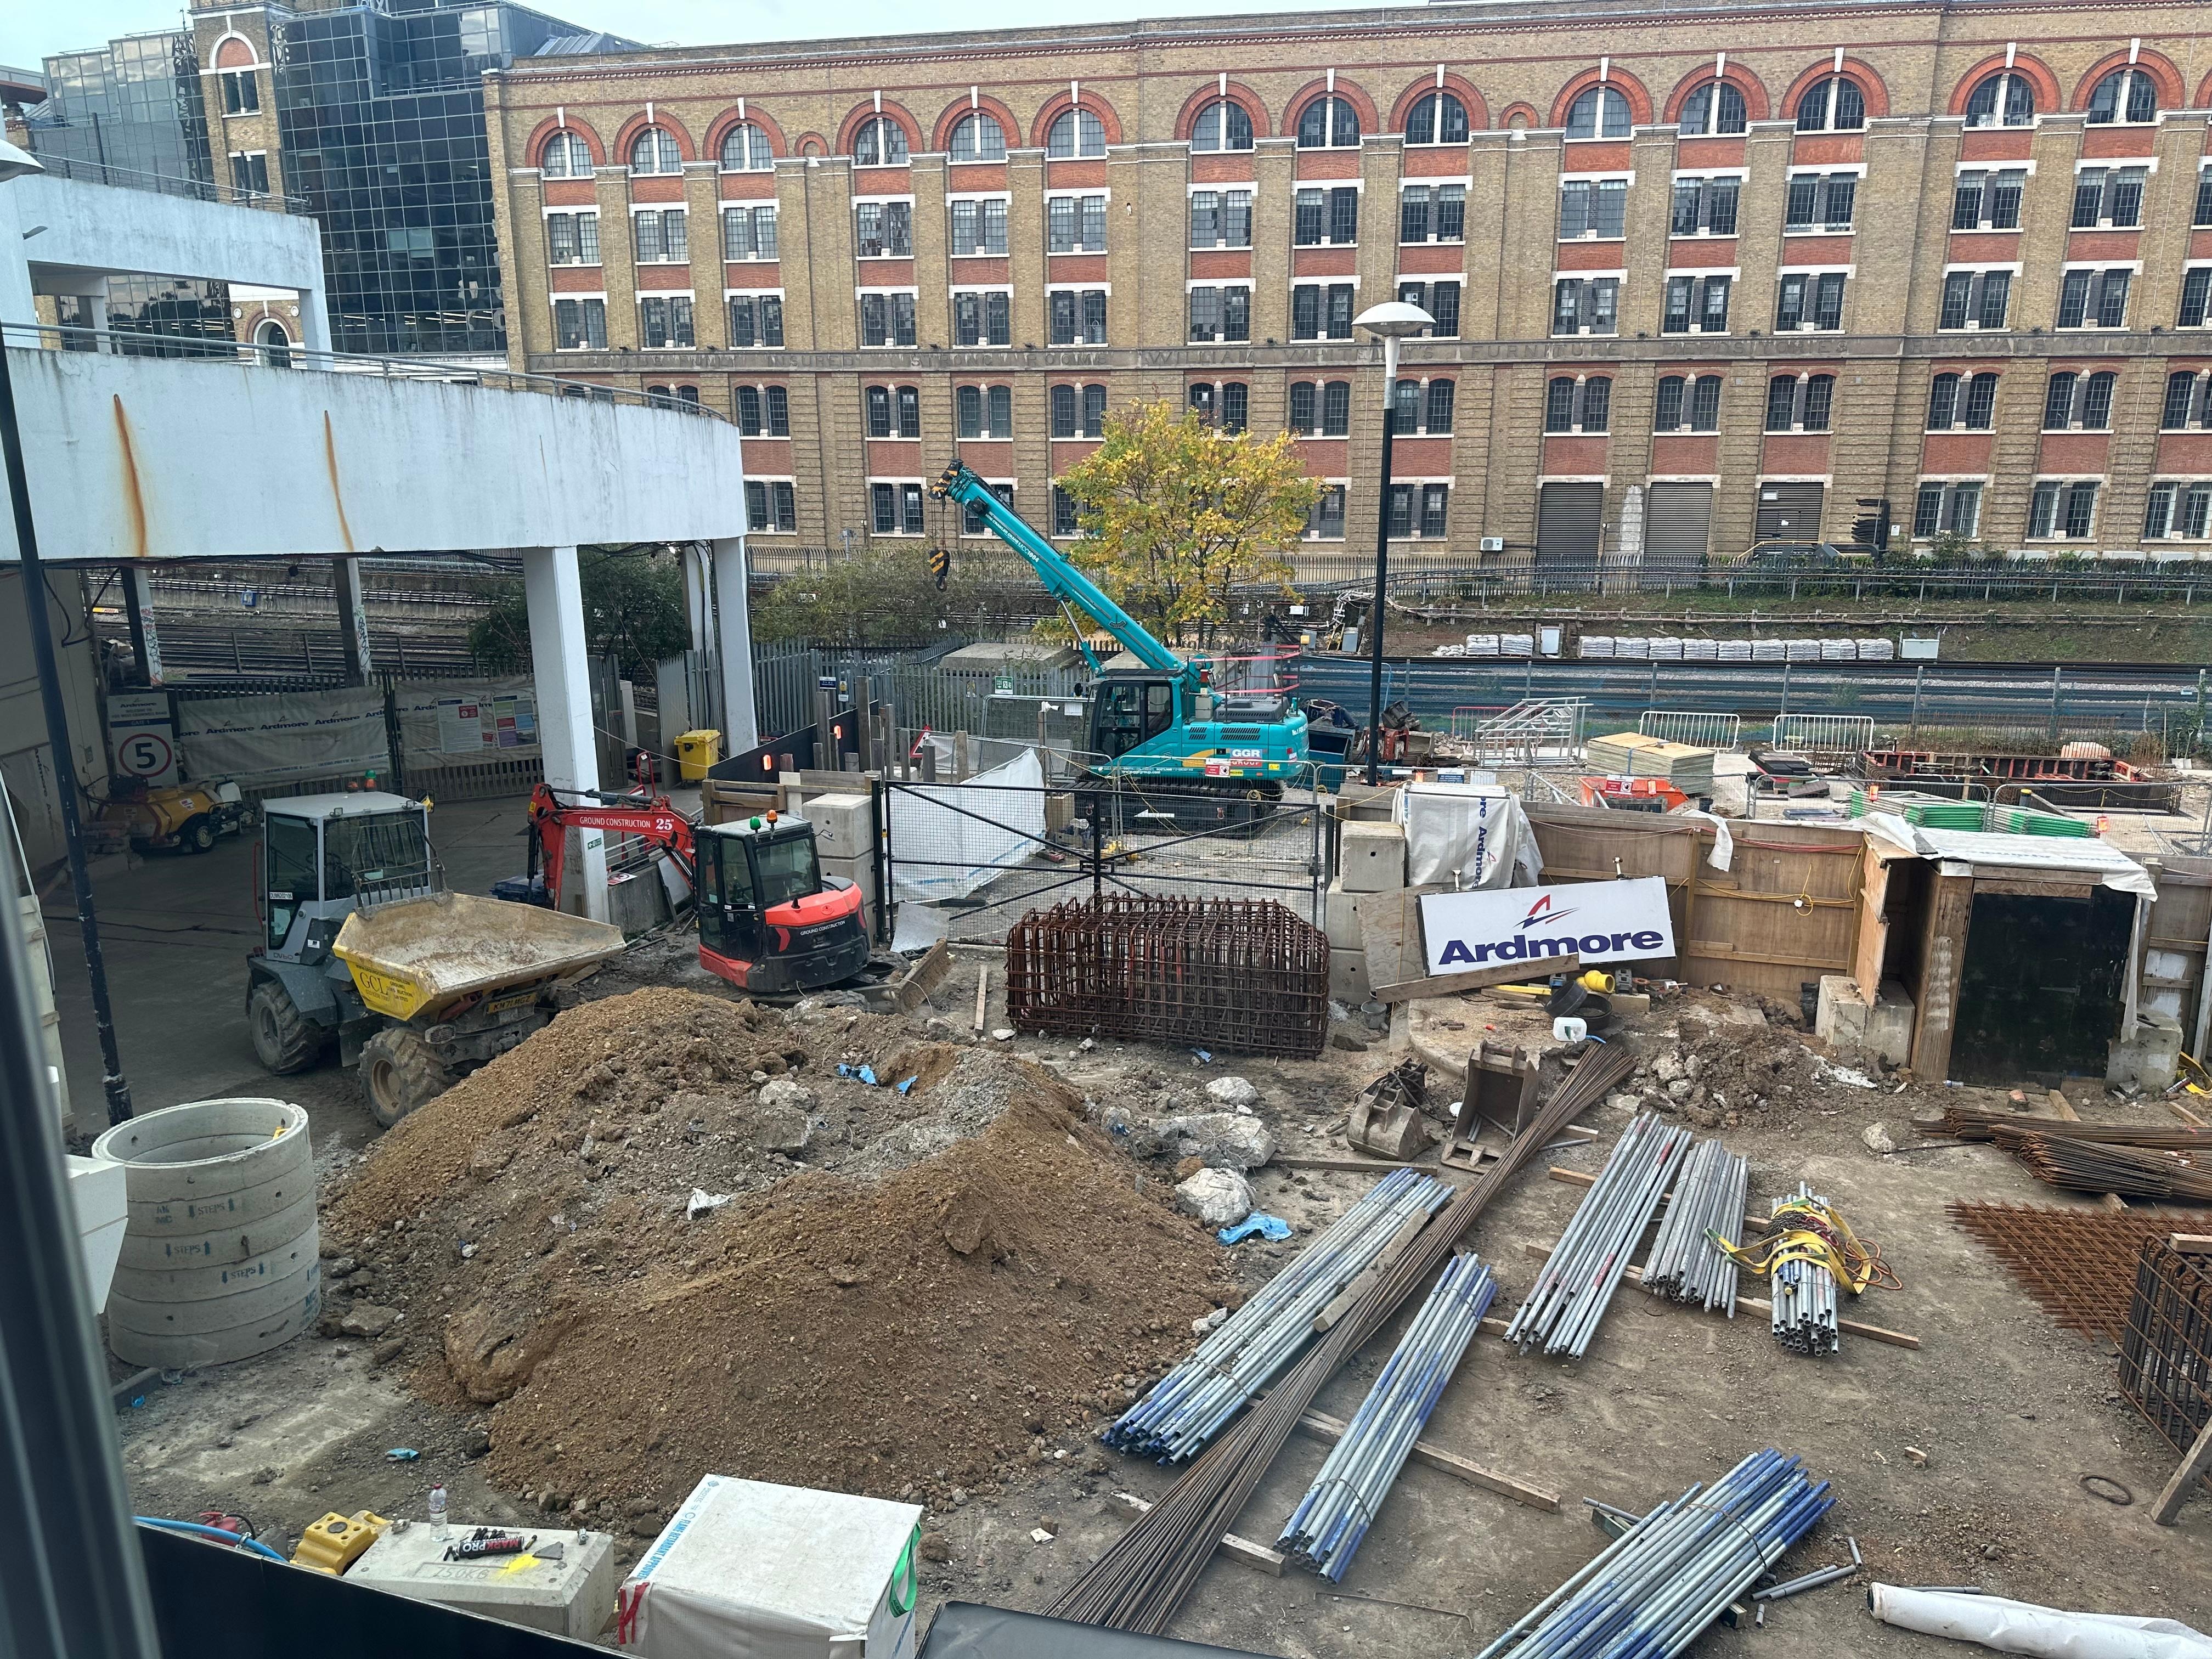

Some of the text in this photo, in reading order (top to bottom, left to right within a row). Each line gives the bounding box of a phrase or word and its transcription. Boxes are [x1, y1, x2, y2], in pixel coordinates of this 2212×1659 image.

[1147, 351, 1254, 364] WILLIAM
[1471, 342, 1620, 359] FURNITURE
[1663, 341, 1848, 355] DEPOSITORIES
[1911, 338, 2045, 352] REMOVALS
[537, 357, 574, 369] ALL
[588, 356, 663, 369] GOODS
[768, 354, 854, 367] INSURED
[910, 354, 992, 366] STRONG
[1028, 353, 1107, 366] ROOMS
[206, 726, 255, 734] Ardmore
[261, 721, 308, 730] Ardmore
[314, 715, 360, 725] Ardmore
[136, 742, 156, 769] 5
[1232, 749, 1260, 757] GGR
[580, 816, 651, 828] GROUND CONSTRUCTION
[1472, 826, 1487, 889] Ardmore
[800, 920, 845, 936] GROUND CONSTRUCTION
[1438, 930, 1663, 965] Ardmore
[360, 972, 388, 996] GCL
[198, 1203, 225, 1216] STEPS
[174, 1244, 201, 1255] STEPS
[230, 1266, 256, 1279] STEPS
[673, 1519, 691, 1533] FLAME
